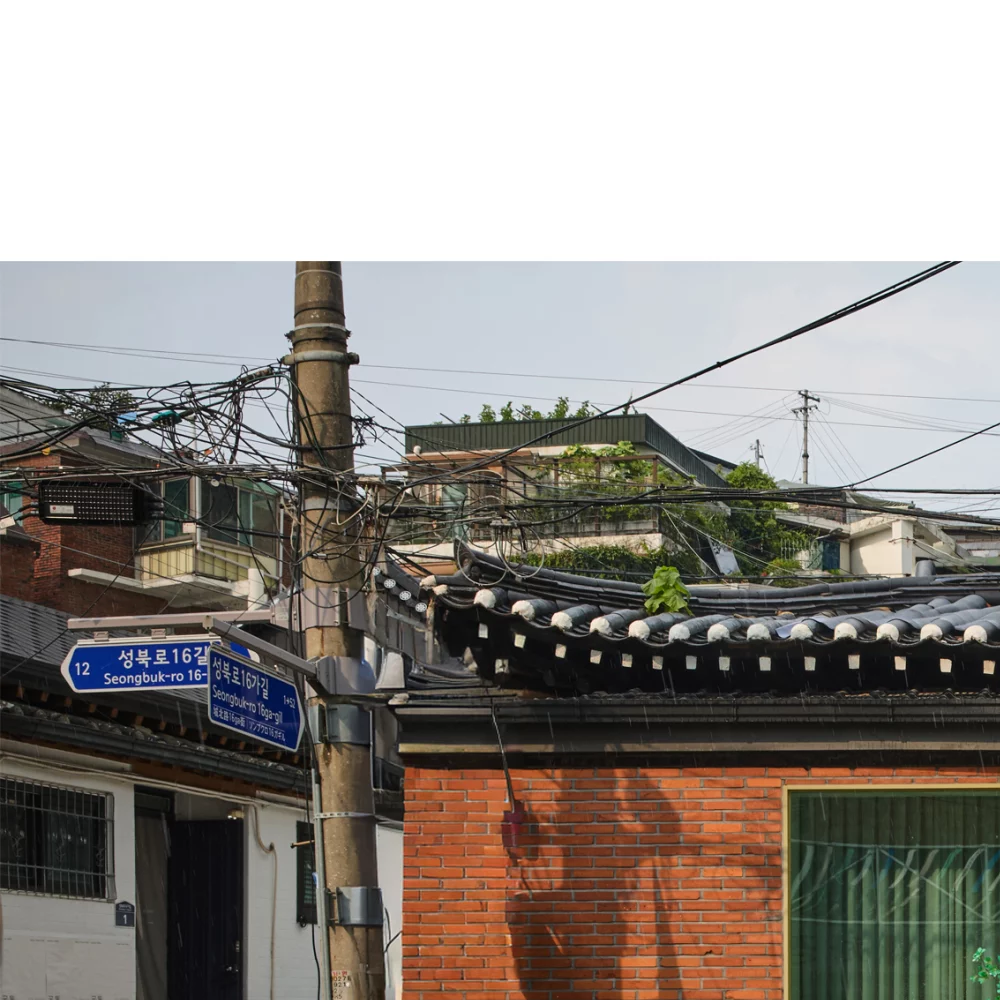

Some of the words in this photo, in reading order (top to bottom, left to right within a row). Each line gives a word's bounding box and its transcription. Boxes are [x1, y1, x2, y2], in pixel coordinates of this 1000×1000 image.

[118, 645, 208, 669] 성북로16길
[75, 662, 90, 676] 12
[104, 671, 184, 686] Seongbuk-ro
[212, 657, 269, 700] 성북로16가길
[212, 684, 257, 713] Seongbuk-ro
[258, 702, 283, 725] 16ga-gil
[123, 914, 127, 925] 1
